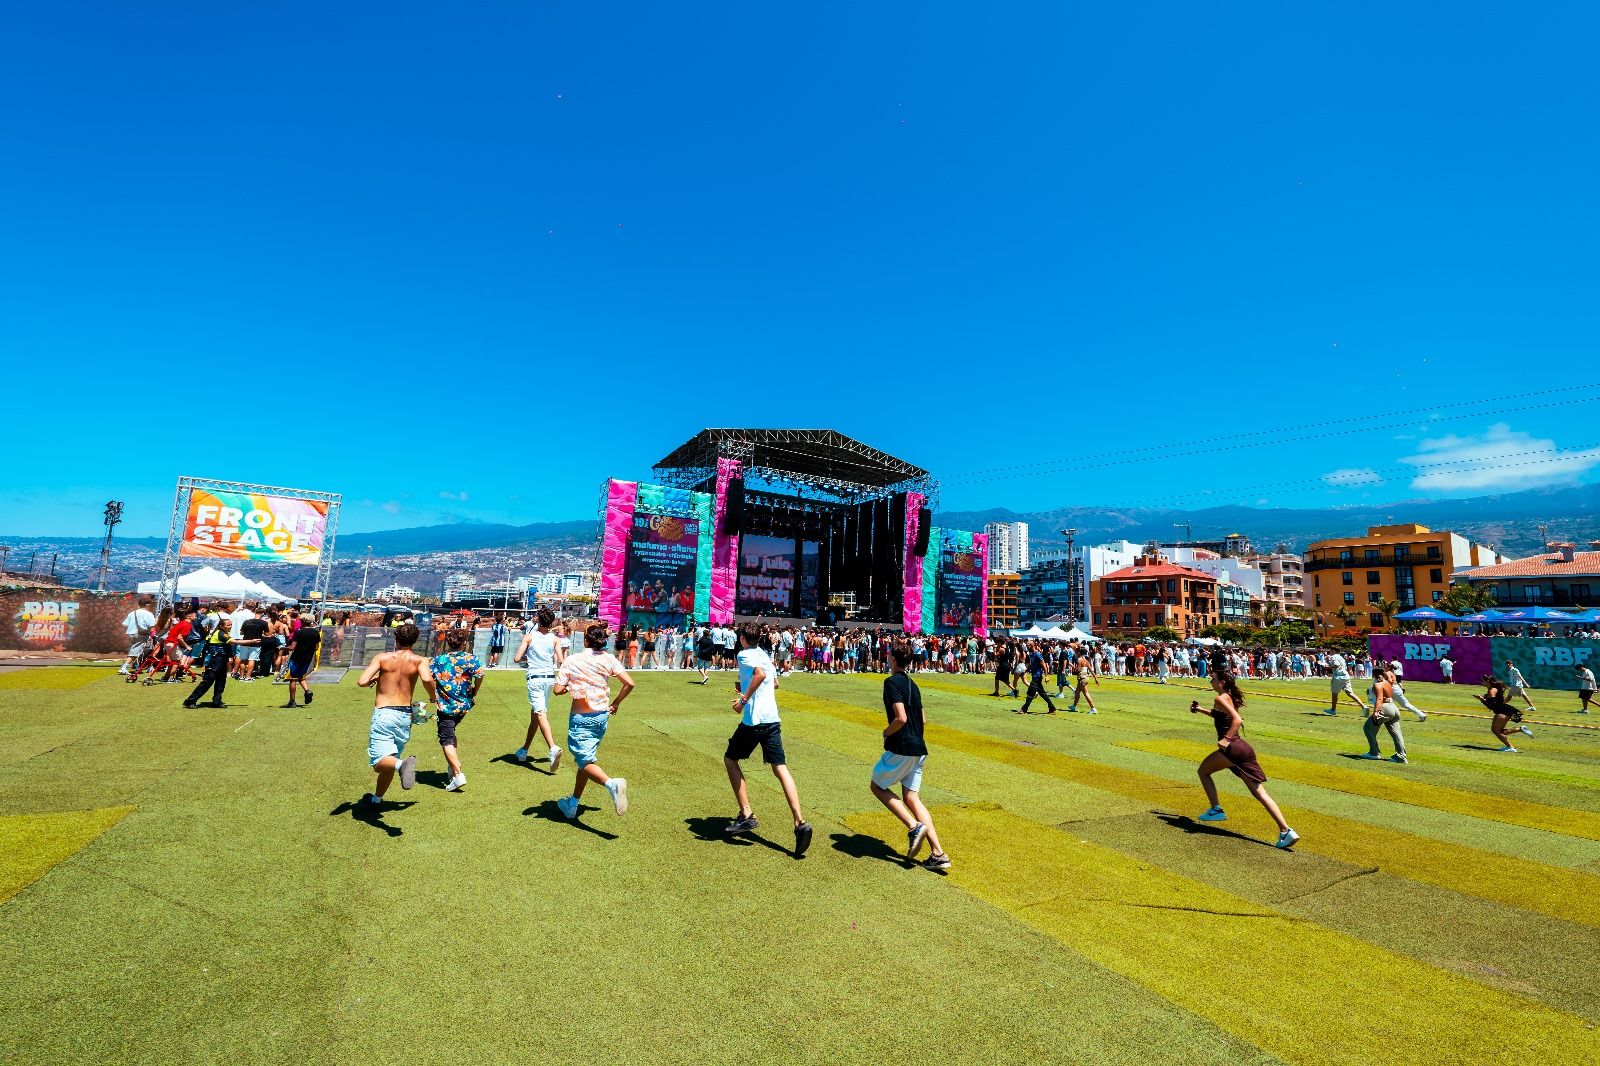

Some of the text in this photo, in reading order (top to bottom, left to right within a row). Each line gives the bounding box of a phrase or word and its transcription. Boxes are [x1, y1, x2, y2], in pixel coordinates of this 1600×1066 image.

[196, 505, 319, 534] FRONT
[192, 525, 311, 552] STAGE
[632, 541, 697, 554] maluma aitana
[746, 554, 759, 568] 19
[740, 573, 795, 590] anta cru
[22, 601, 80, 622] RBF
[1404, 642, 1450, 661] RBF
[1534, 646, 1592, 666] RBF
